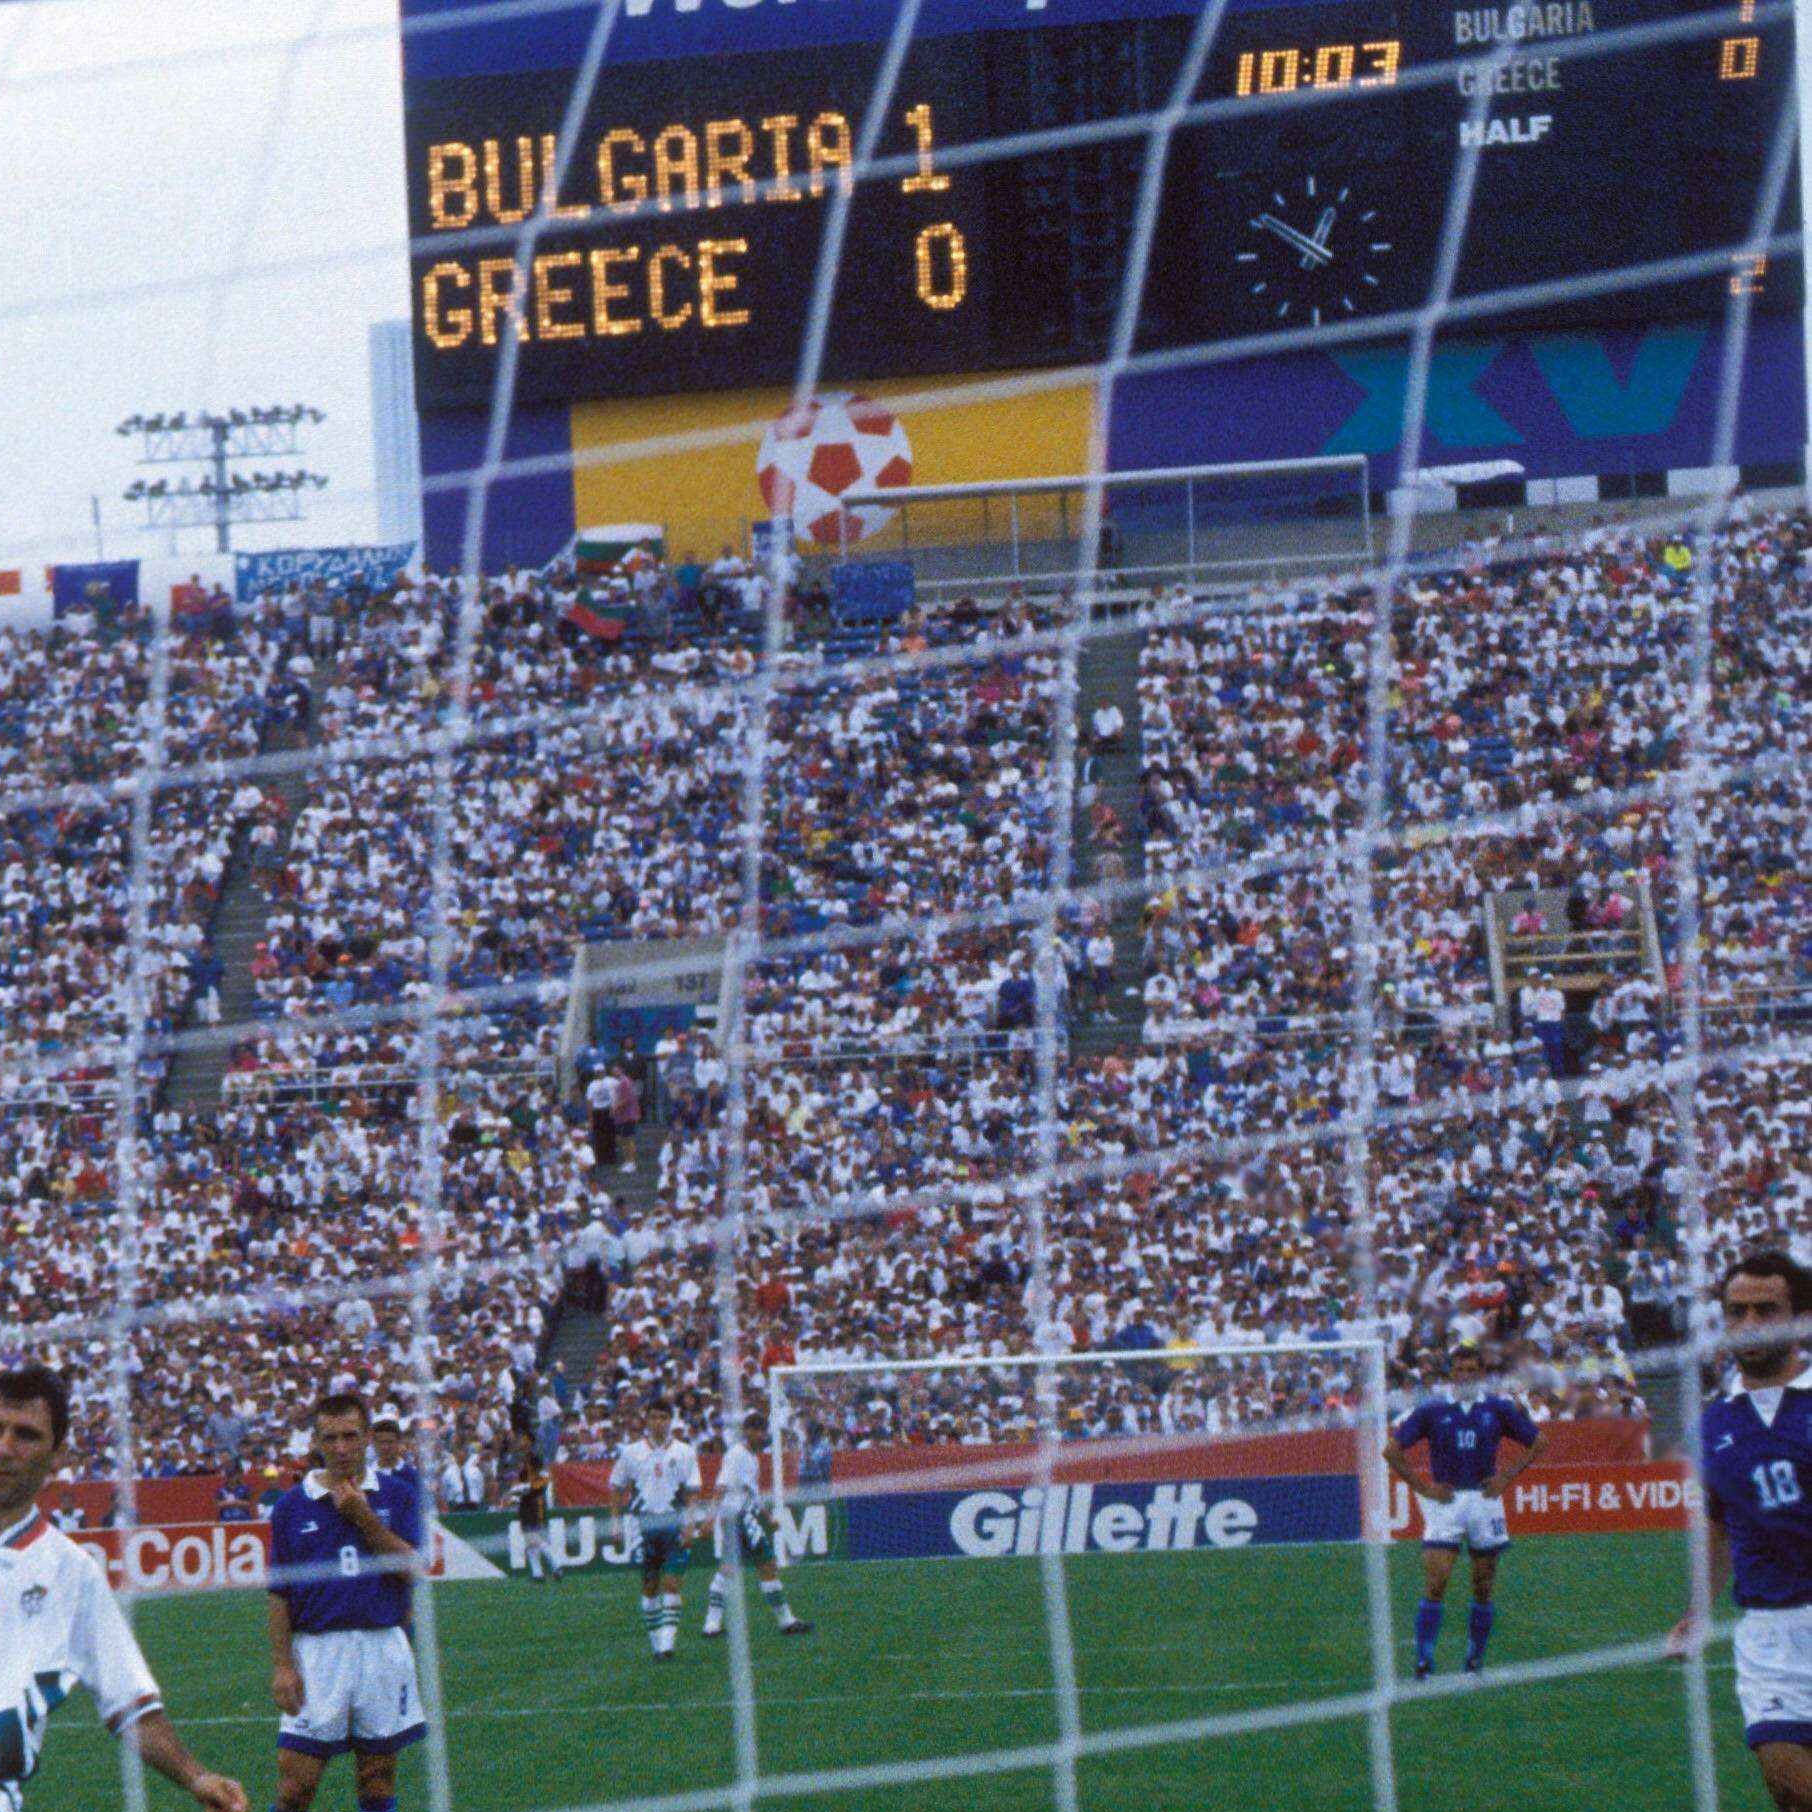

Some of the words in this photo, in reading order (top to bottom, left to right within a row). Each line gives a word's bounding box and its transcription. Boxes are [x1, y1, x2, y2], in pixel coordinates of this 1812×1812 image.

[1236, 41, 1400, 97] 10:03
[1719, 36, 1759, 79] 0
[1459, 115, 1555, 148] HALF
[427, 111, 854, 229] BULGARIA
[902, 104, 949, 192] 1
[422, 238, 750, 349] GREECE
[915, 222, 966, 309] 0
[949, 1482, 1259, 1559] Gillette
[1515, 1481, 1591, 1515] HI-FI
[1625, 1477, 1704, 1511] VIDE
[338, 1544, 360, 1577] 8
